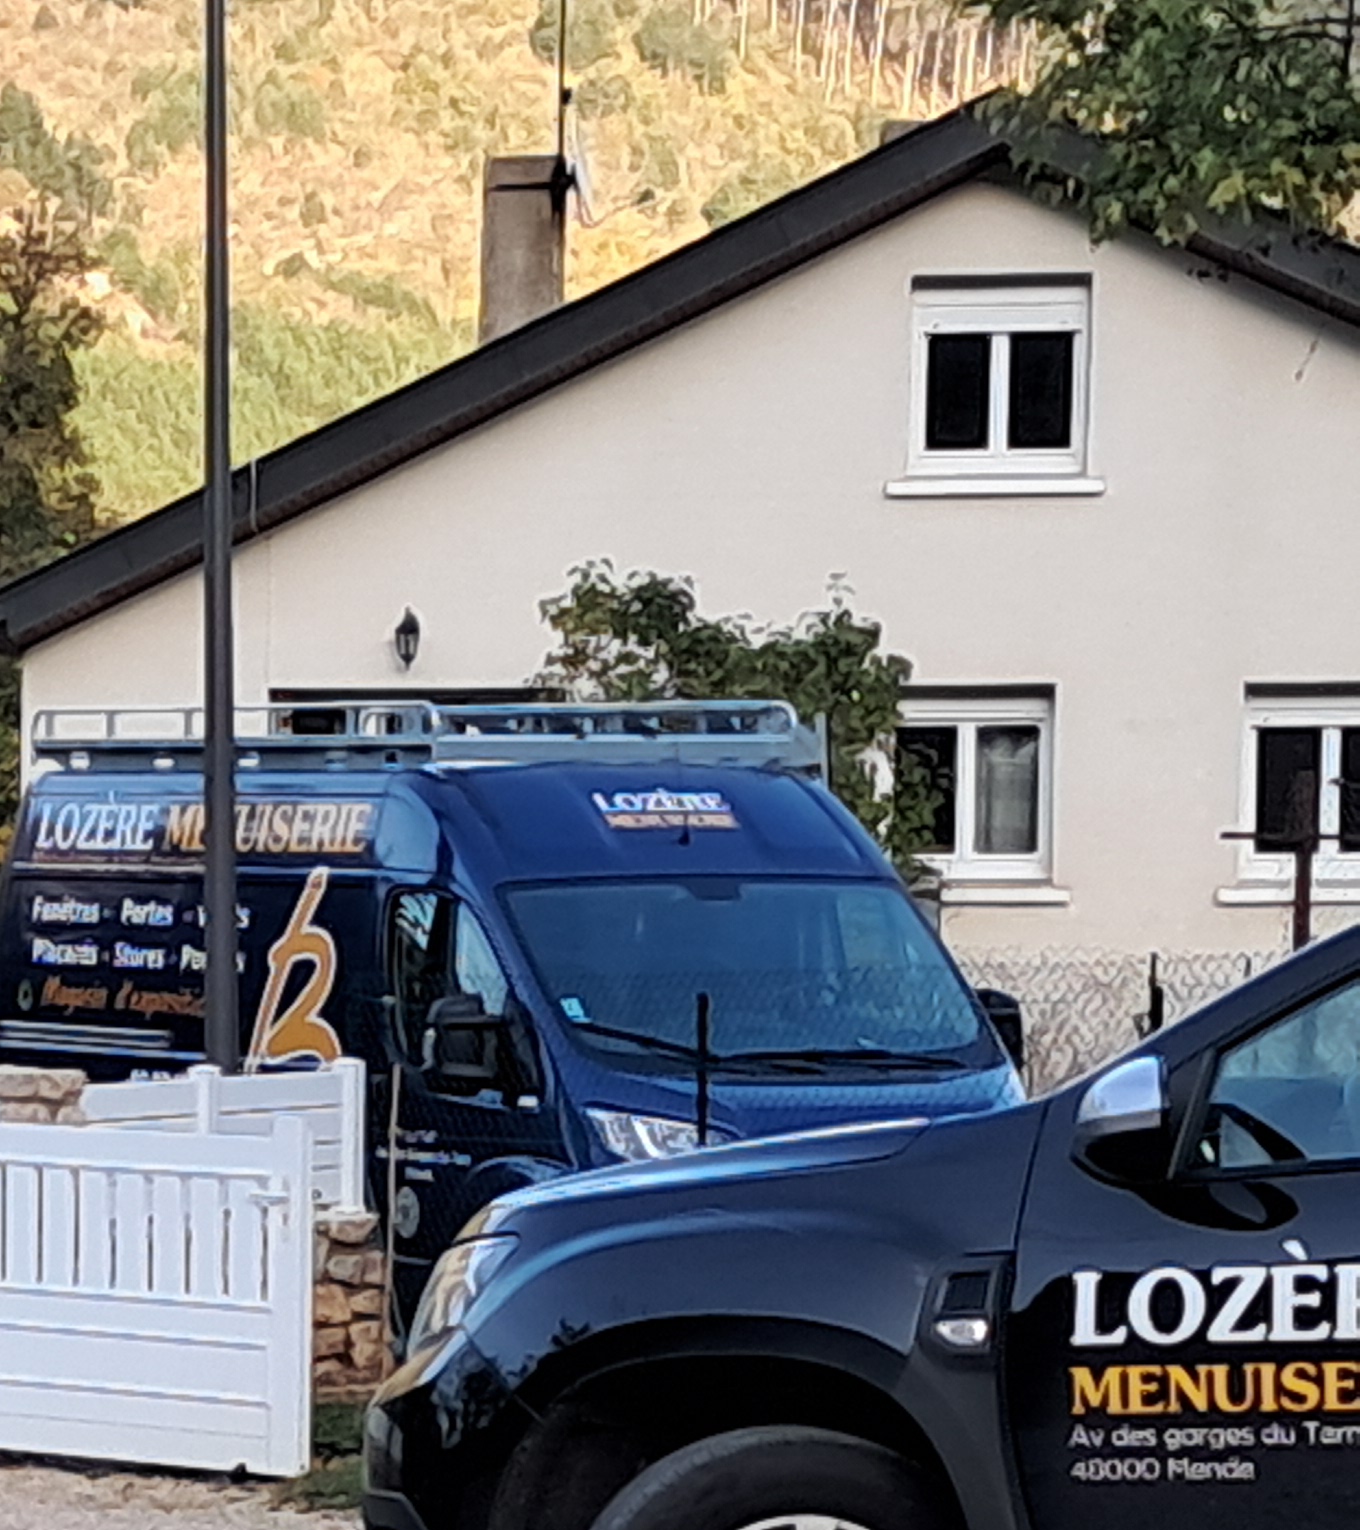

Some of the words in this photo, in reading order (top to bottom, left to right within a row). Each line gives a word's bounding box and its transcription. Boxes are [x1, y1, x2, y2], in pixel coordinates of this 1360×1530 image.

[36, 791, 160, 850] LOZÈRE
[32, 895, 100, 925] Fenêtres
[121, 898, 174, 926] Portes
[113, 941, 166, 970] Stores
[1068, 1423, 1105, 1448] Av
[1111, 1423, 1157, 1447] des
[1162, 1426, 1255, 1451] gorges
[1260, 1421, 1296, 1446] du
[1167, 1456, 1256, 1481] Mende
